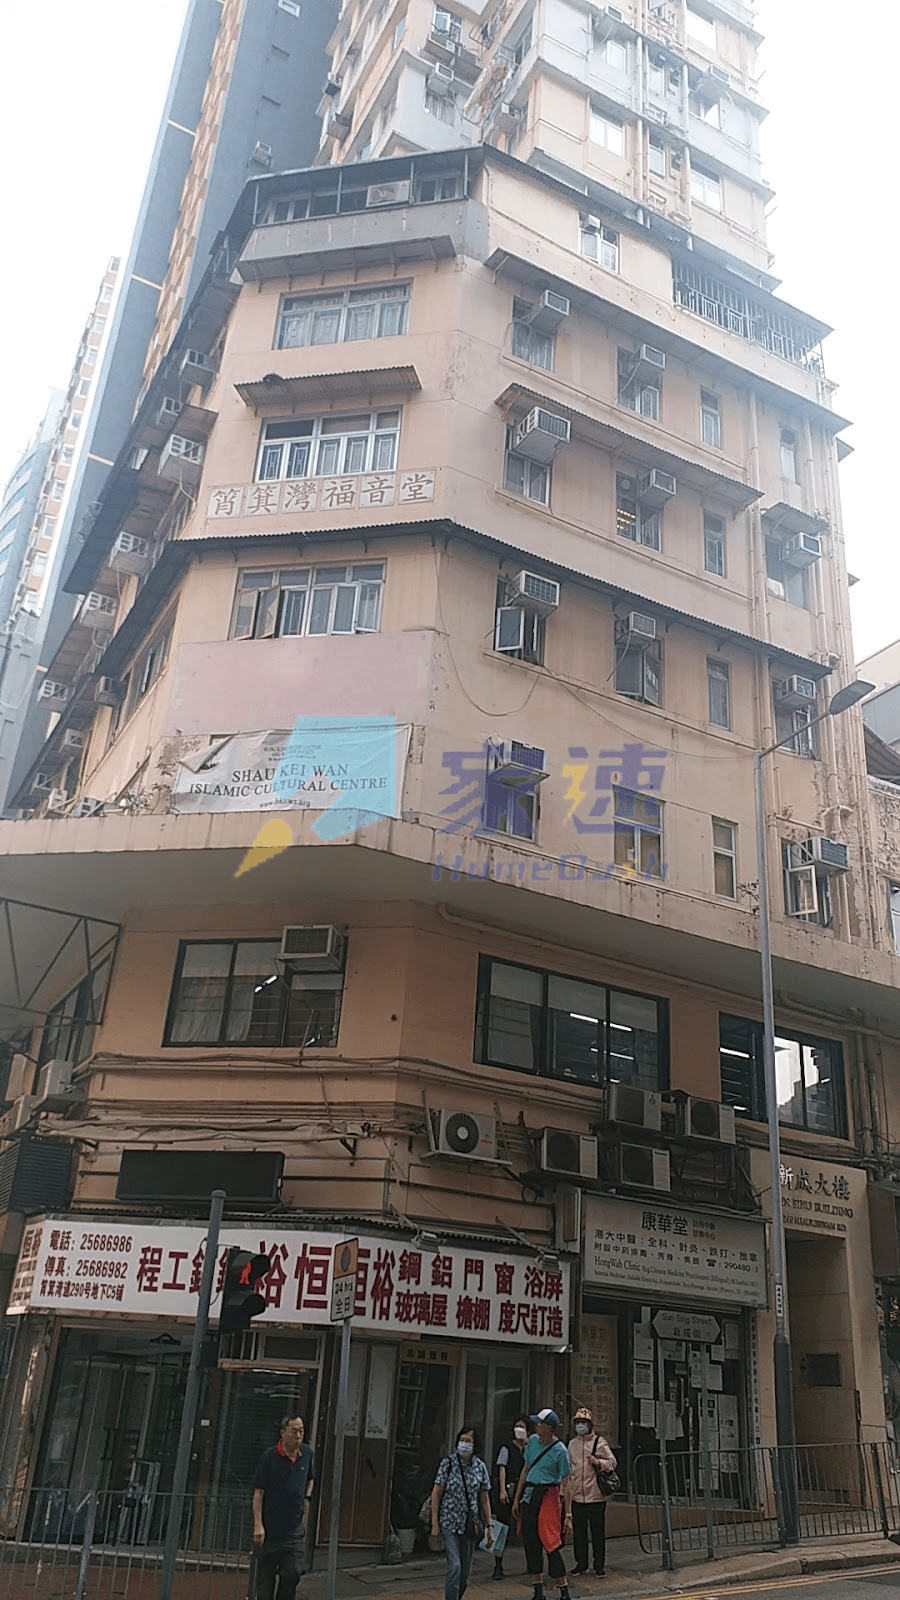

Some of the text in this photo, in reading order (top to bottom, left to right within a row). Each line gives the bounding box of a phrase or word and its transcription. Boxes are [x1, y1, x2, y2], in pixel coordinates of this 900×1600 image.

[213, 473, 434, 516] 筲箕灣福音堂
[232, 763, 349, 783] SHAU KEI WAN
[189, 777, 387, 797] ISLAMIC CULTURAL CENTRE
[792, 1199, 812, 1210] SING
[814, 1202, 853, 1218] BUILDING
[641, 1210, 688, 1237] 康華堂
[79, 1233, 133, 1253] 25686986
[75, 1259, 128, 1280] 25686982
[624, 1260, 641, 1271] Clinic
[335, 1281, 353, 1294] 24 hrs
[335, 1297, 350, 1315] 全日
[395, 1290, 448, 1327] 玻璃屋
[498, 1299, 563, 1339] 度尺訂造
[662, 1312, 712, 1326] Sun Sing Street
